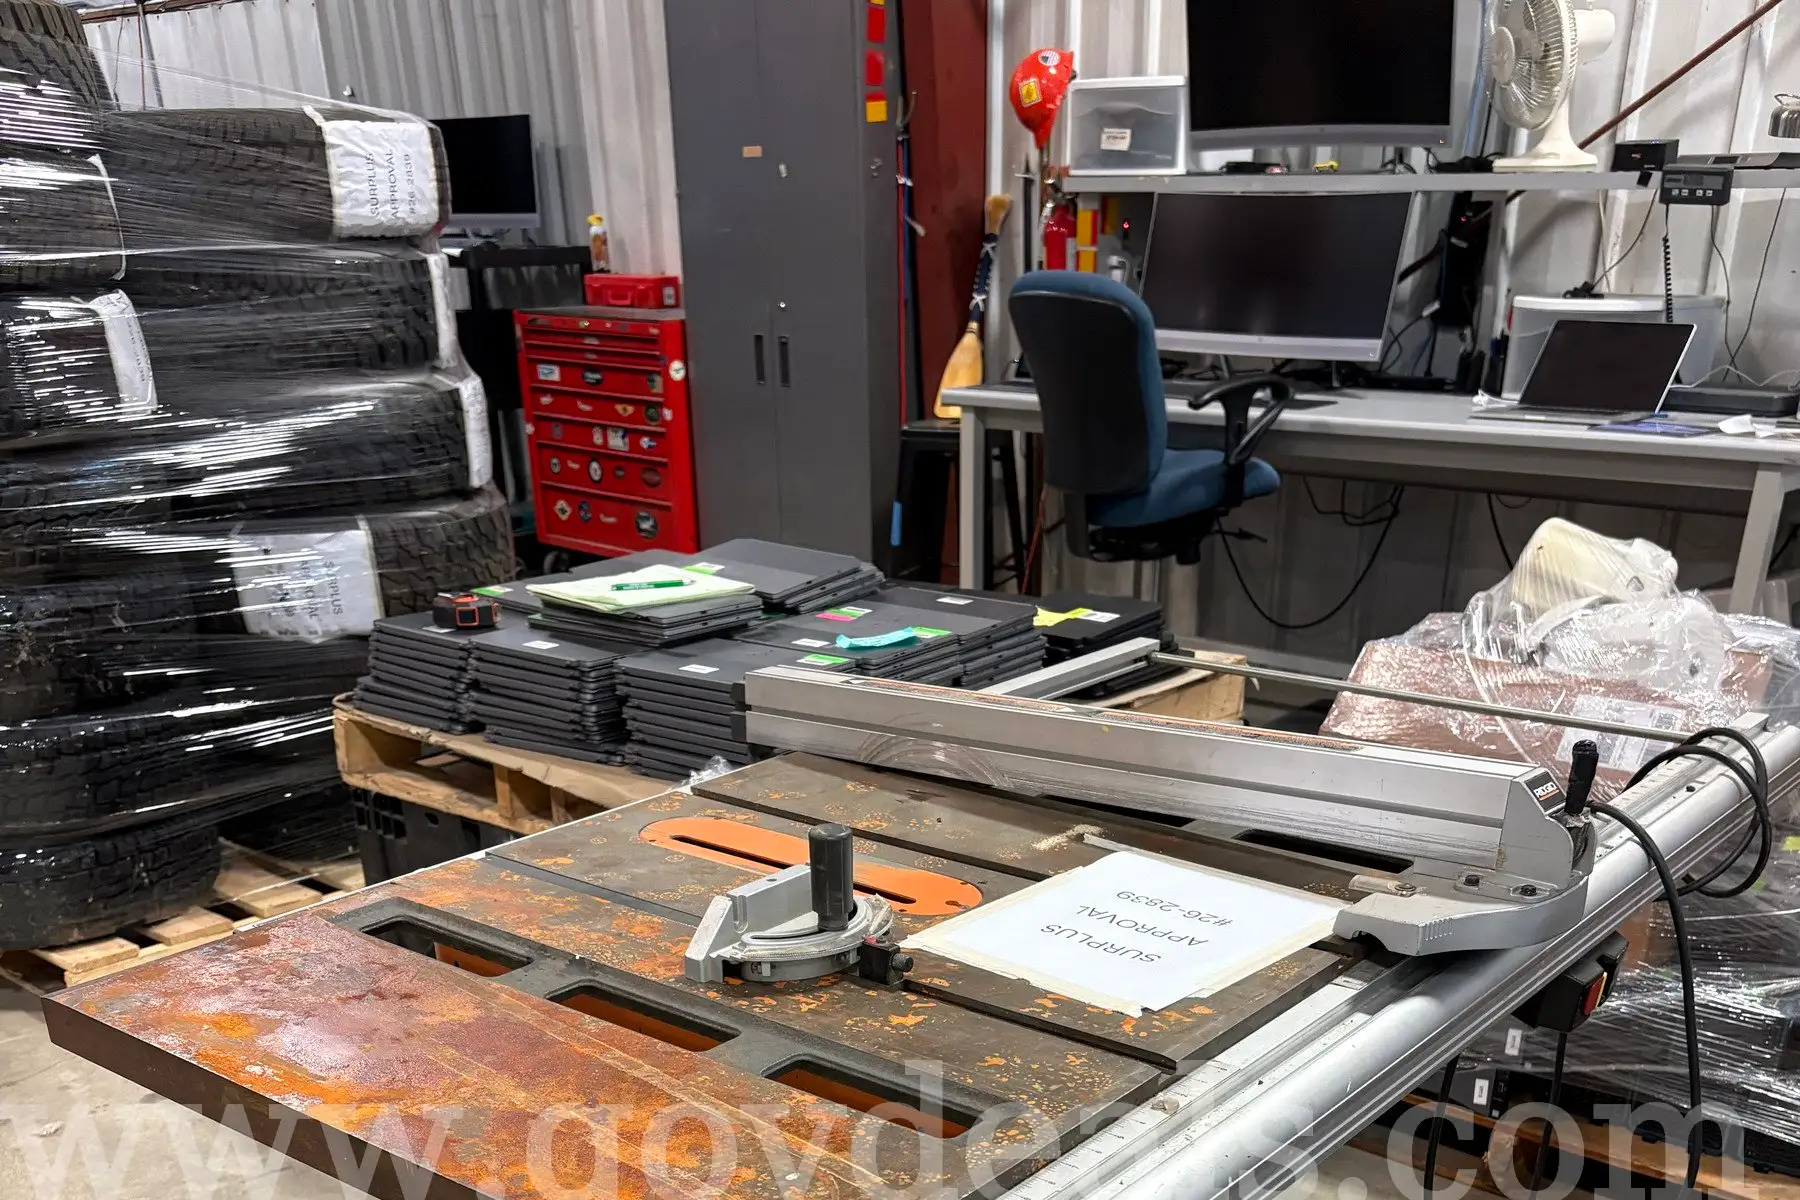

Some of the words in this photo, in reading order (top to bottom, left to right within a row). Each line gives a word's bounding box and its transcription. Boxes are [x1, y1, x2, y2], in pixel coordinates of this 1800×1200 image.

[366, 153, 381, 217] SURPLUS
[385, 148, 401, 220] APPROVAL
[1076, 904, 1210, 947] APPROVAL
[1116, 889, 1234, 928] #26-2839
[1040, 923, 1162, 964] SURPLUS
